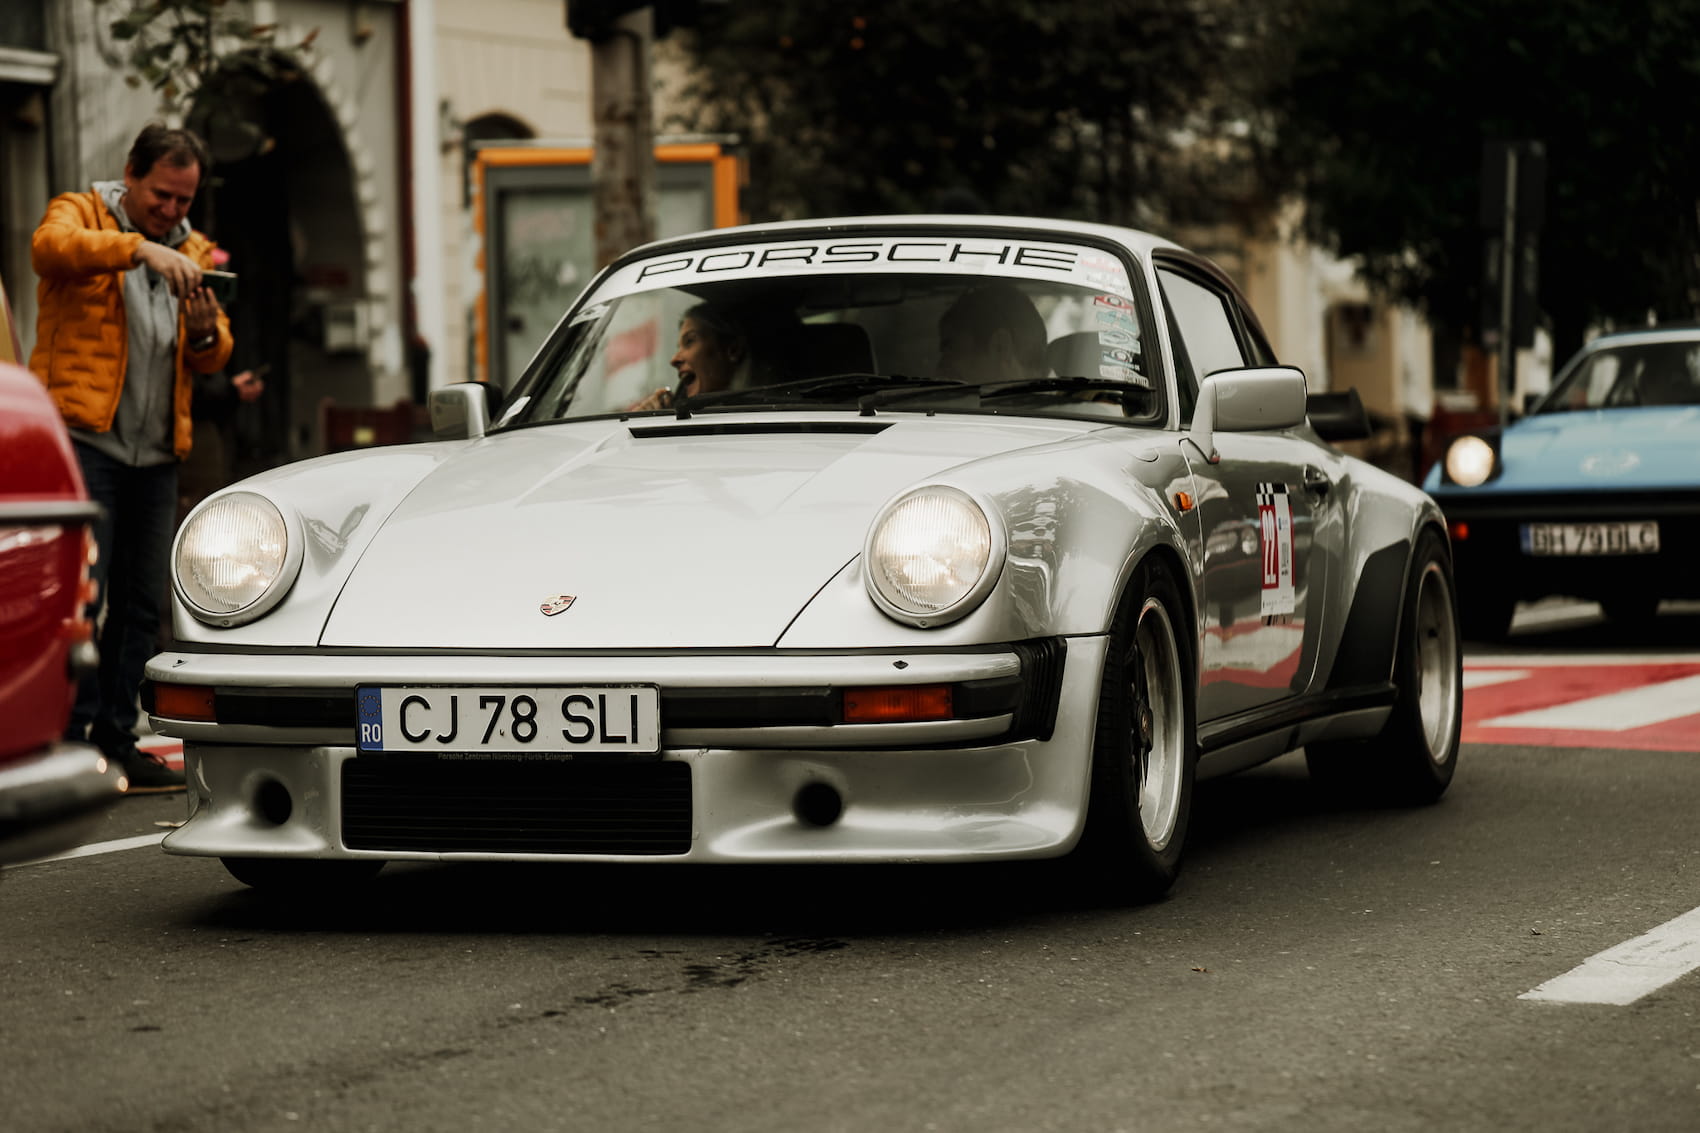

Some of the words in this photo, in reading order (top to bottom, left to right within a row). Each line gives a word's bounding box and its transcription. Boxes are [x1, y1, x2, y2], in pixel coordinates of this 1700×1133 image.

[635, 243, 1079, 284] PORSCHE
[1262, 509, 1277, 584] 22
[361, 723, 381, 743] RO
[399, 694, 458, 744] CJ
[479, 694, 538, 744] 78
[561, 694, 639, 744] SLI
[438, 753, 463, 761] Porsche
